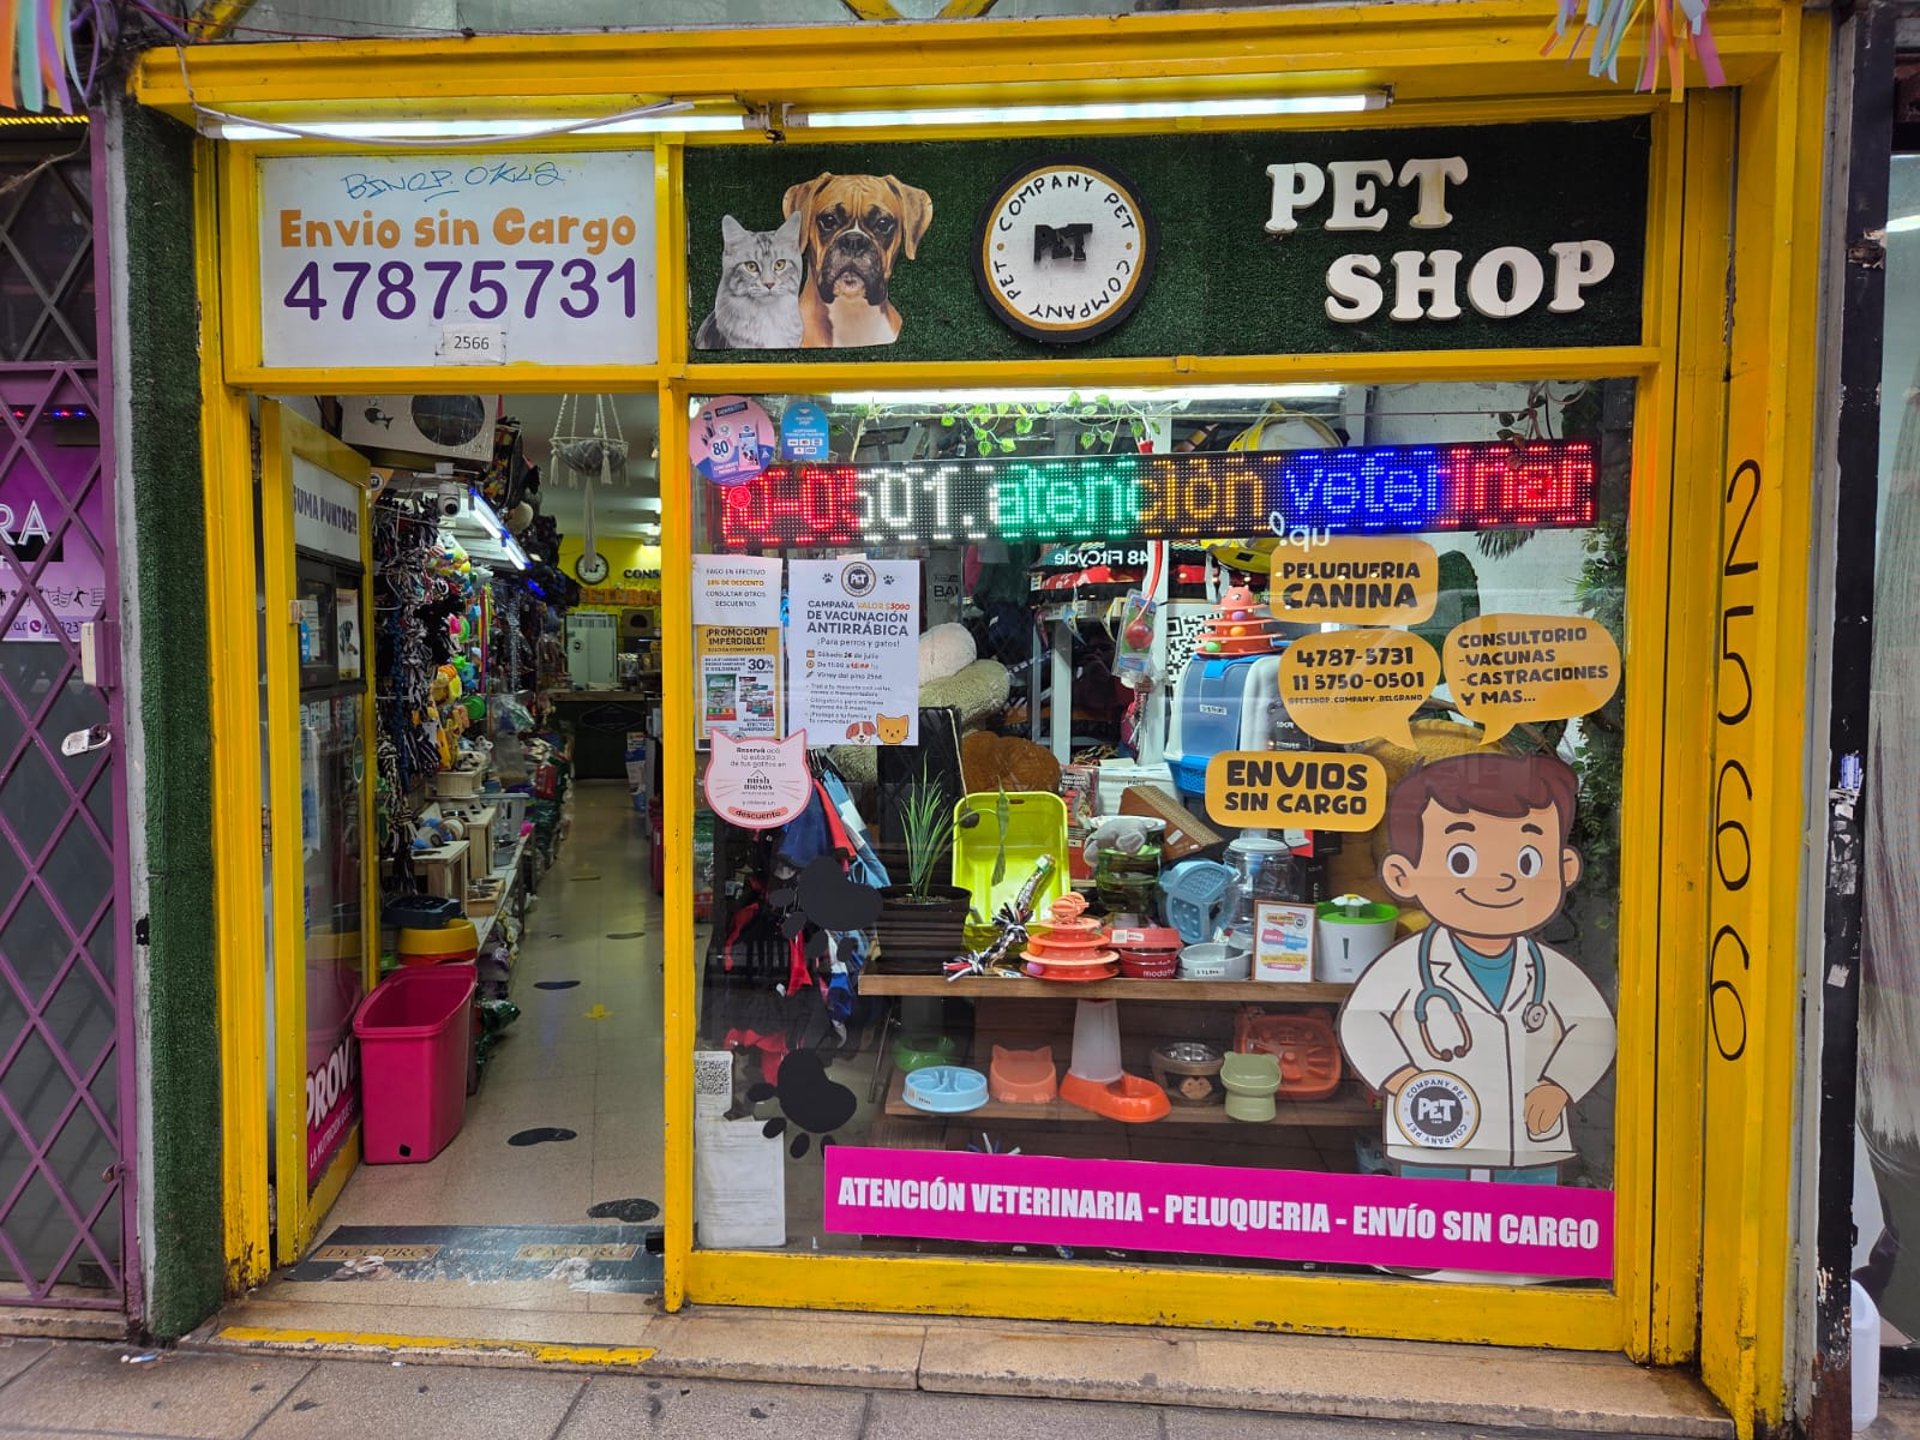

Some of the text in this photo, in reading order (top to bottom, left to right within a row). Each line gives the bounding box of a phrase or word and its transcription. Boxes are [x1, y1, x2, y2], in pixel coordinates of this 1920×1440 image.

[1000, 174, 1135, 232] COMPANY PET
[1264, 156, 1469, 233] PET
[280, 208, 637, 255] Envio sin Cargo
[283, 258, 637, 320] 47875731
[994, 260, 1130, 319] COMPANY PET
[1324, 239, 1615, 323] SHOP
[453, 335, 490, 350] 2566
[712, 440, 729, 456] 80
[988, 464, 1266, 528] atención
[1282, 561, 1421, 580] PELUQUERIA
[808, 600, 855, 609] CAMPAÑA
[1283, 583, 1419, 609] CANINA
[807, 610, 908, 623] DE VACUNACIÓN
[807, 622, 909, 636] ANTIRRÁBICA
[1458, 627, 1588, 649] CONSULTORIO
[709, 637, 766, 646] IMPERDIBLE!
[840, 638, 866, 648] perros
[748, 658, 774, 670] 30%
[1297, 647, 1414, 667] 4787-5731
[1293, 672, 1424, 690] 11 5750-0501
[1461, 692, 1475, 706] Y
[1709, 458, 1762, 1062] 2566
[1227, 760, 1368, 791] ENVIOS
[1225, 791, 1367, 815] SIN CARGO
[736, 809, 781, 820] descuento
[1406, 1079, 1468, 1101] COMPANY PET
[1417, 1097, 1456, 1122] PET
[1406, 1122, 1468, 1145] COMPANY PET
[837, 1177, 965, 1212] ATENCIÓN
[970, 1183, 1143, 1223] VETERINARIA
[1165, 1193, 1330, 1234] PELUQUERIA
[1352, 1203, 1437, 1240] ENVÍO
[1442, 1210, 1494, 1243] SIN
[1499, 1213, 1599, 1250] CARGO
